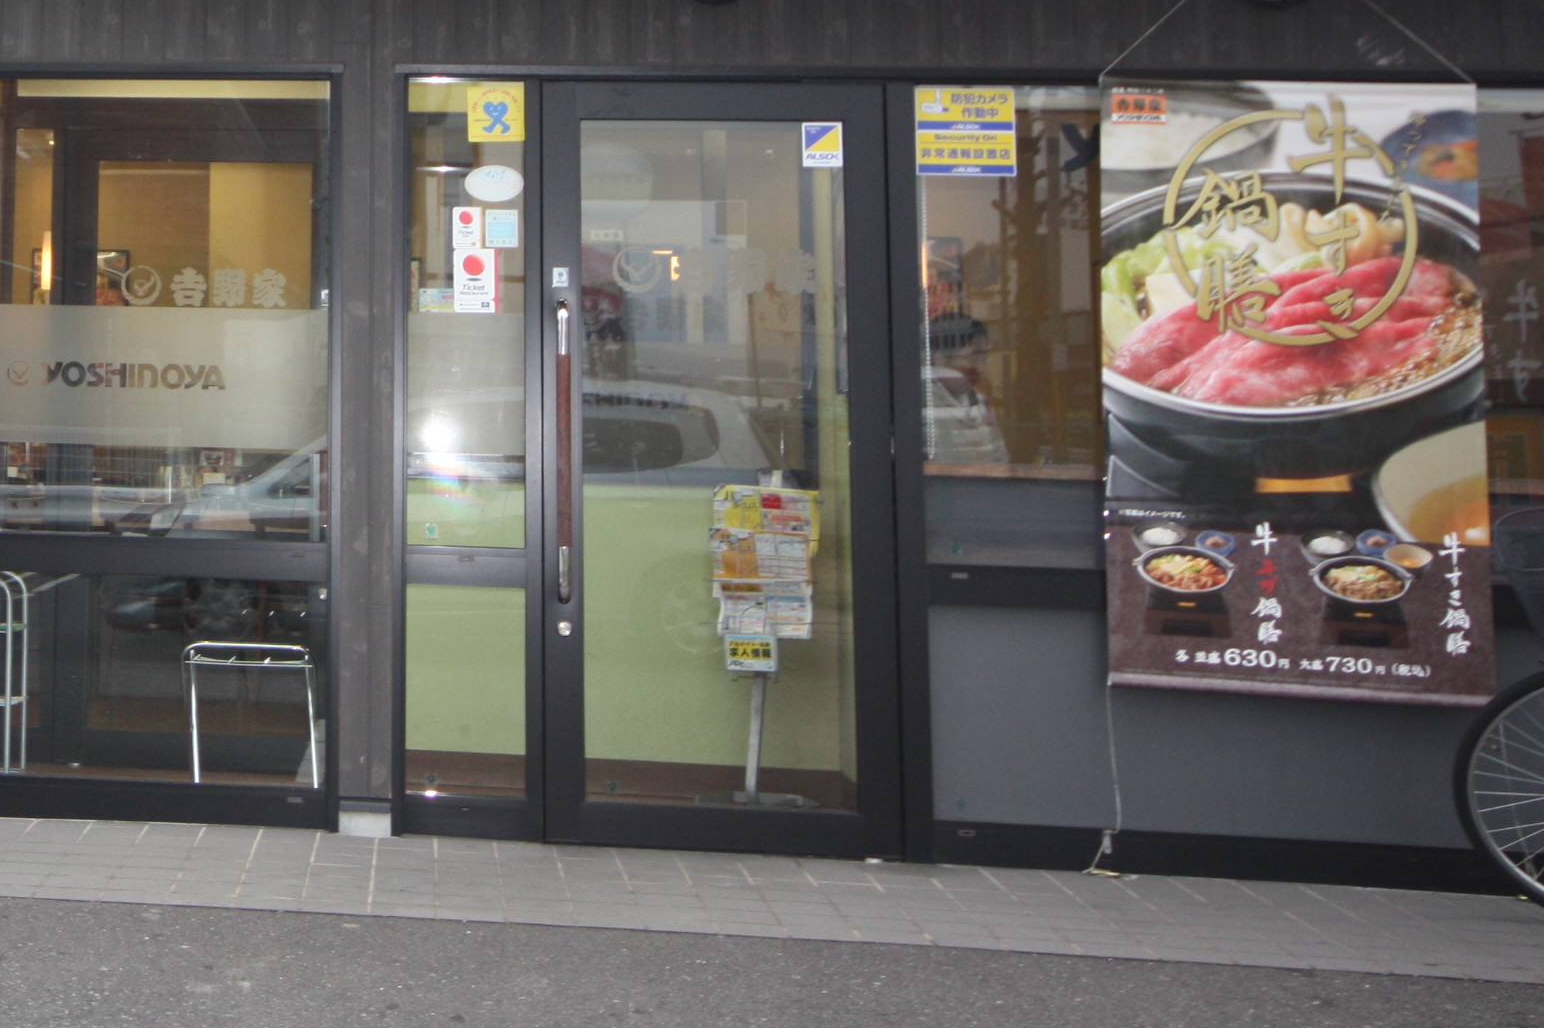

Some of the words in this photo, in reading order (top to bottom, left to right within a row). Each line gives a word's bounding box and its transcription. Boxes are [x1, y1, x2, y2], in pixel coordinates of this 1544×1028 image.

[950, 93, 1009, 105] 防犯カメラ
[961, 107, 999, 119] 作動中
[934, 133, 981, 142] Security
[804, 152, 840, 160] ALSOK
[170, 268, 287, 309] 吉野家
[462, 283, 486, 291] Ticket
[41, 361, 227, 391] YOSHINOYA
[1438, 532, 1472, 657] 牛すき鍋膳
[1175, 649, 1190, 662] 各
